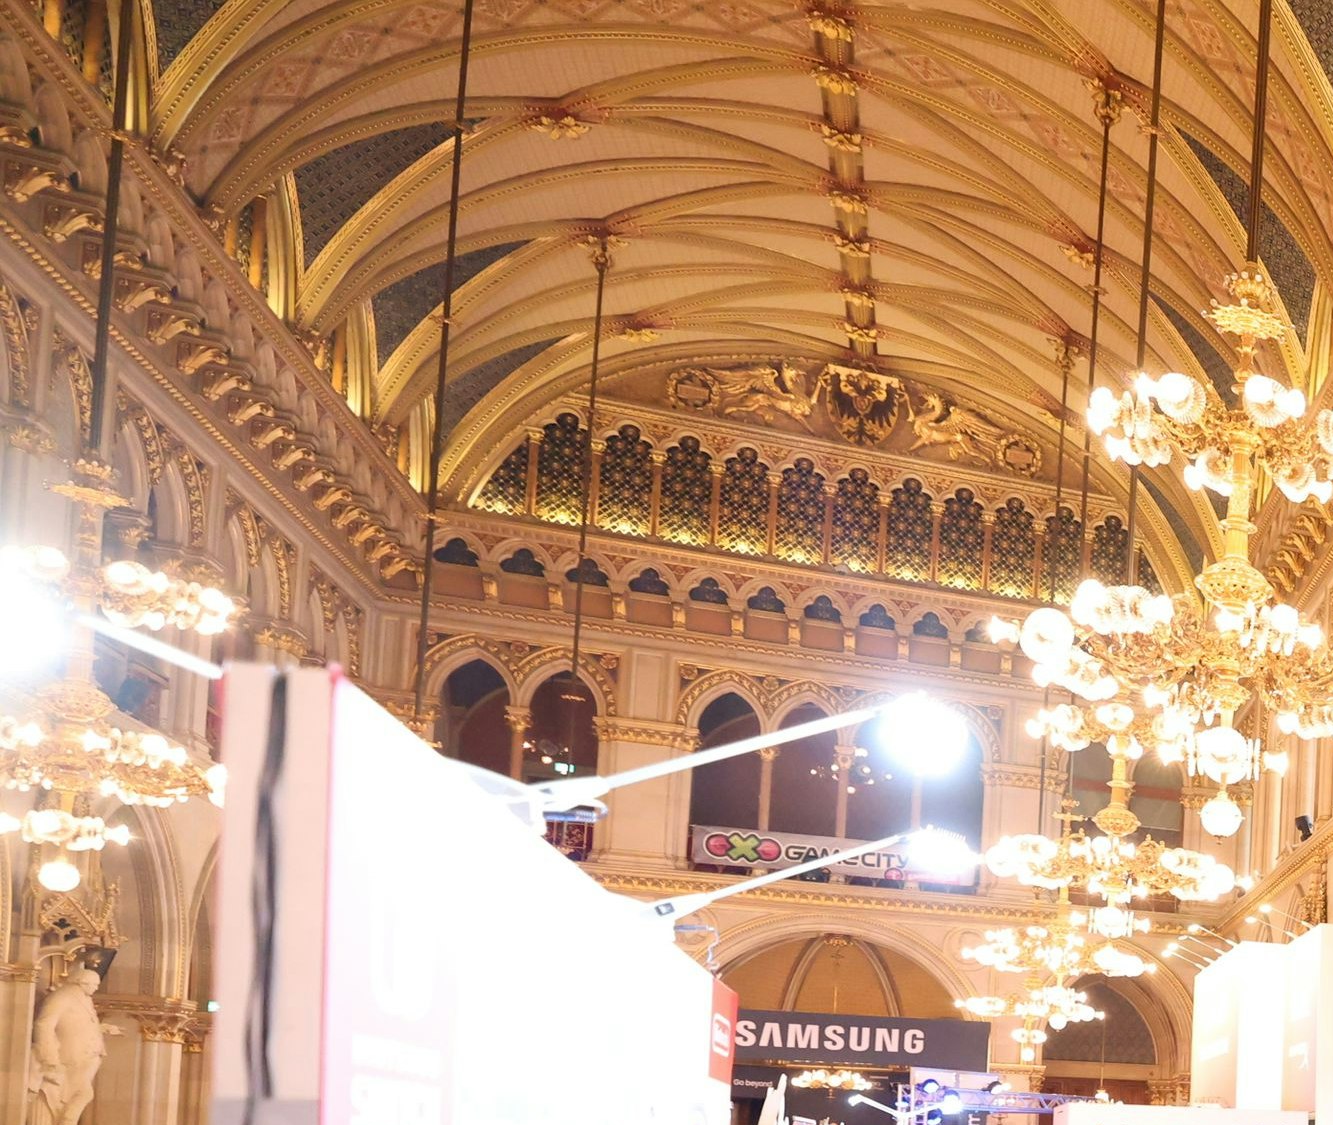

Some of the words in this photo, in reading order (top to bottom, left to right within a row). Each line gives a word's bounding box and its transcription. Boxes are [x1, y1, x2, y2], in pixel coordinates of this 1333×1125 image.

[735, 1020, 925, 1054] SAMSUNG
[733, 1079, 744, 1087] Go
[745, 1079, 773, 1089] beyond
